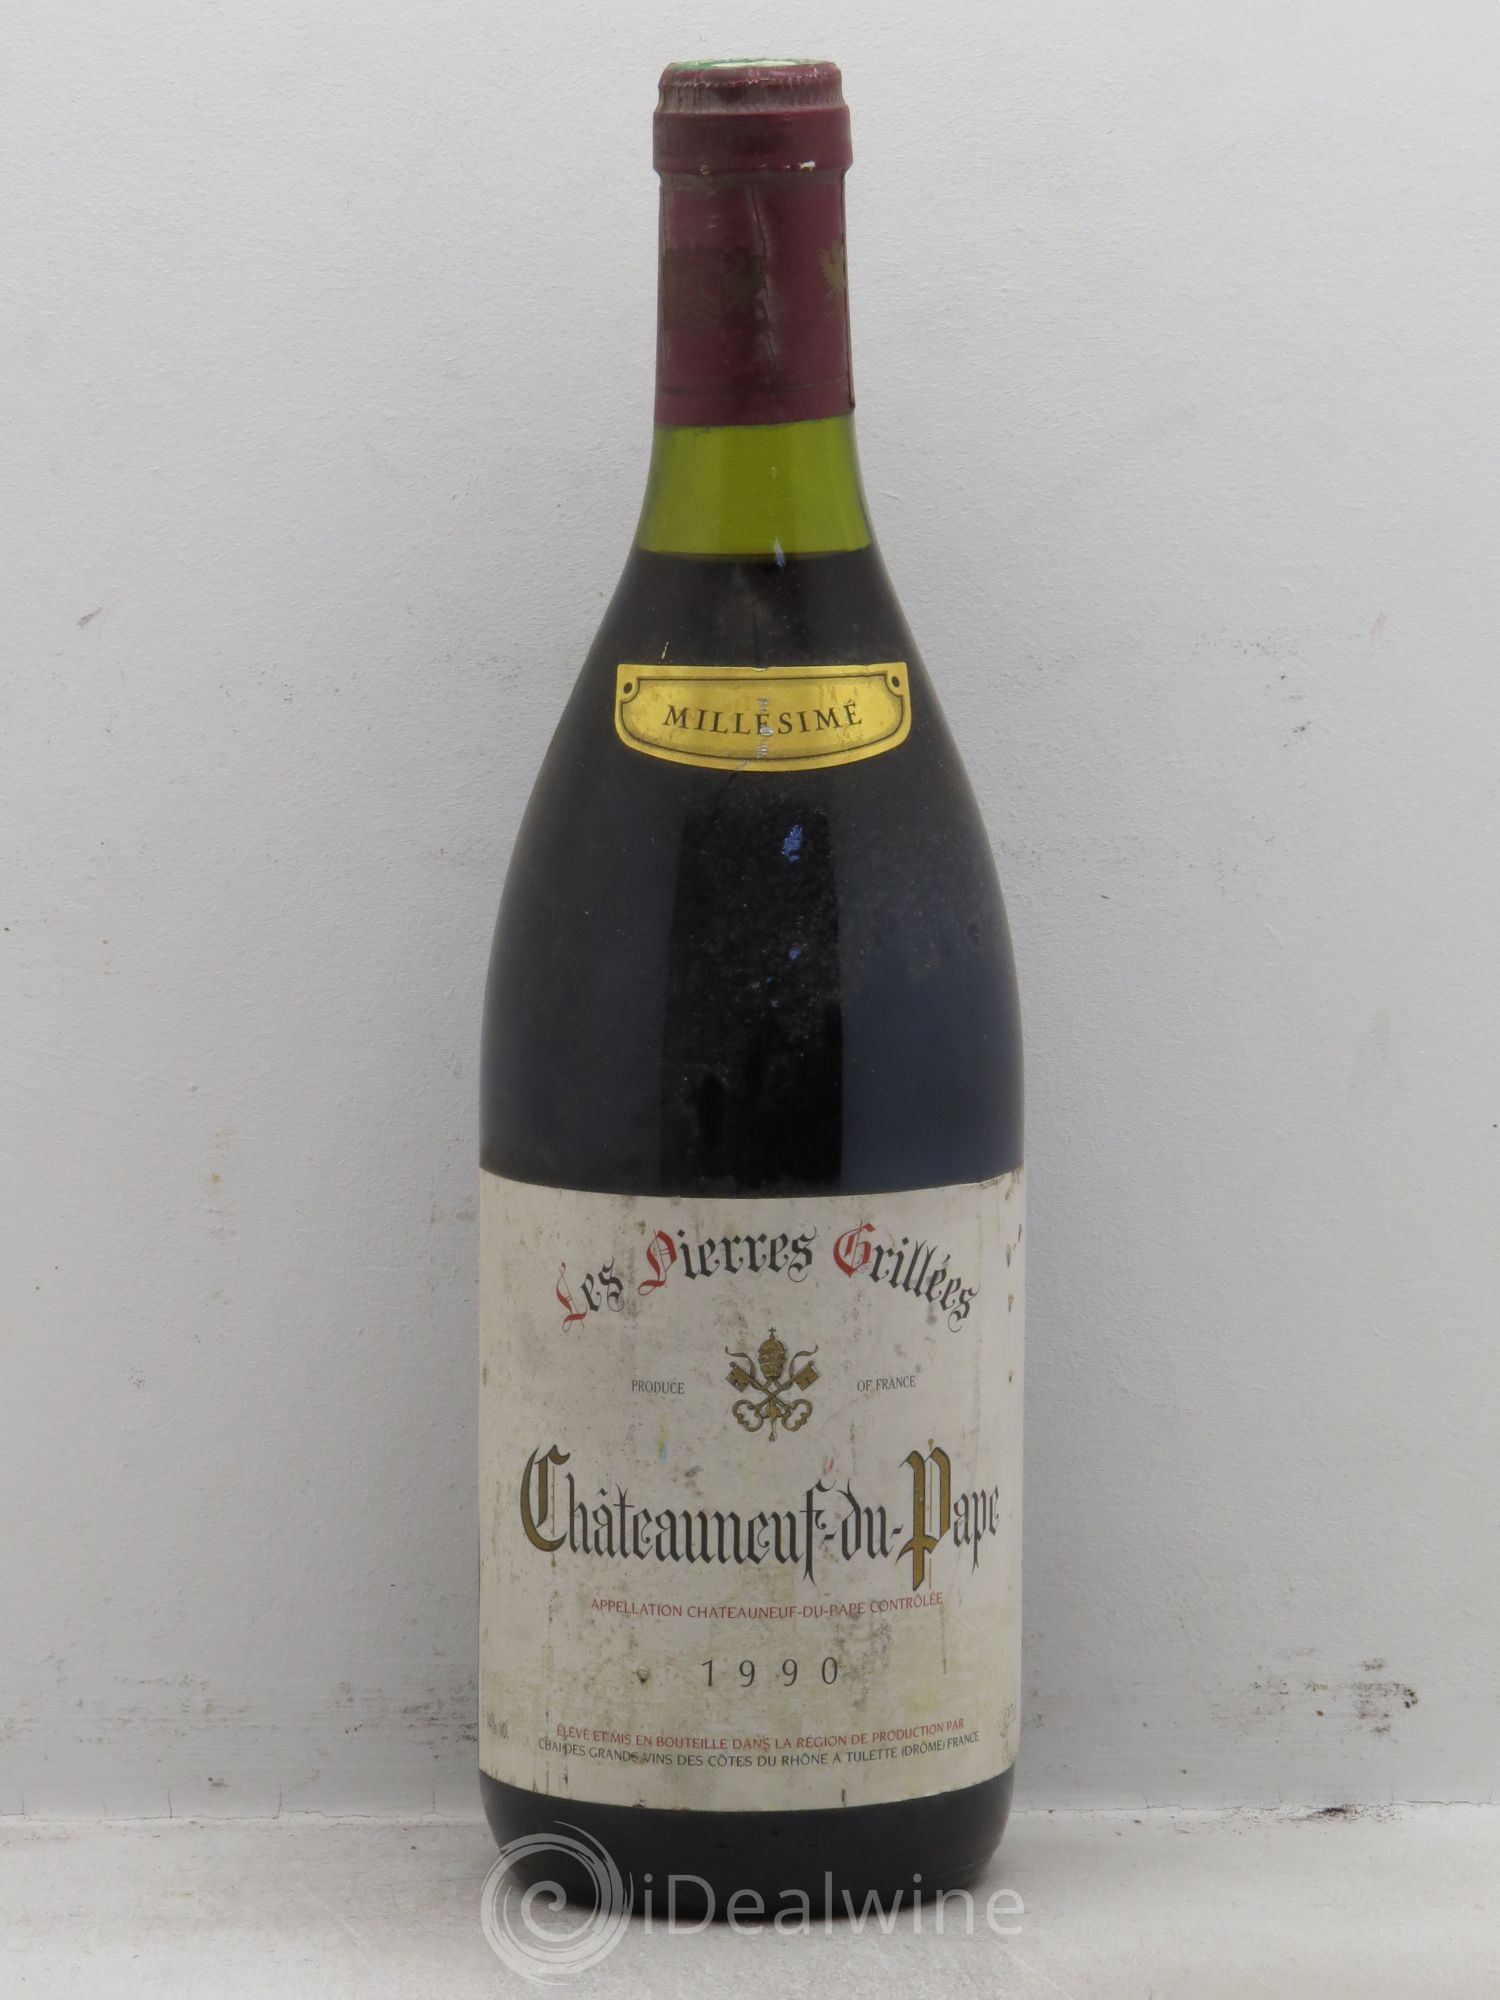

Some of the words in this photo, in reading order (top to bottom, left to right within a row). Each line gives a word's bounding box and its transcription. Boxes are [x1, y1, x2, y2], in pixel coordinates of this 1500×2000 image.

[556, 1256, 625, 1332] Les
[638, 1225, 817, 1296] Pierres
[833, 1219, 979, 1333] Grillées
[631, 1378, 686, 1394] PRODUCE
[857, 1379, 873, 1392] OF
[876, 1375, 916, 1390] FRANCE
[591, 1597, 683, 1618] APPELLATION
[687, 1602, 866, 1620] CHATEAUNEUF-DU-PAPE
[870, 1591, 944, 1614] CONTRÔLÉE
[564, 1743, 586, 1757] DES
[588, 1746, 639, 1762] GRANDS
[677, 1754, 703, 1767] DES
[708, 1752, 753, 1768] CÔTES
[757, 1755, 777, 1767] DU
[781, 1751, 828, 1767] RHÔNE
[832, 1753, 842, 1765] A
[847, 1747, 898, 1763] TULETTE
[947, 1730, 980, 1749] FRANCE
[593, 1730, 610, 1743] ET
[610, 1733, 632, 1745] MIS
[636, 1734, 653, 1747] EN
[656, 1735, 728, 1750] BOUTEILLE
[732, 1736, 771, 1752] DANS
[775, 1736, 792, 1750] LA
[796, 1734, 848, 1748] RÉGION
[851, 1732, 869, 1746] DE
[872, 1723, 945, 1744] PRODUCTION
[946, 1717, 966, 1732] PAR
